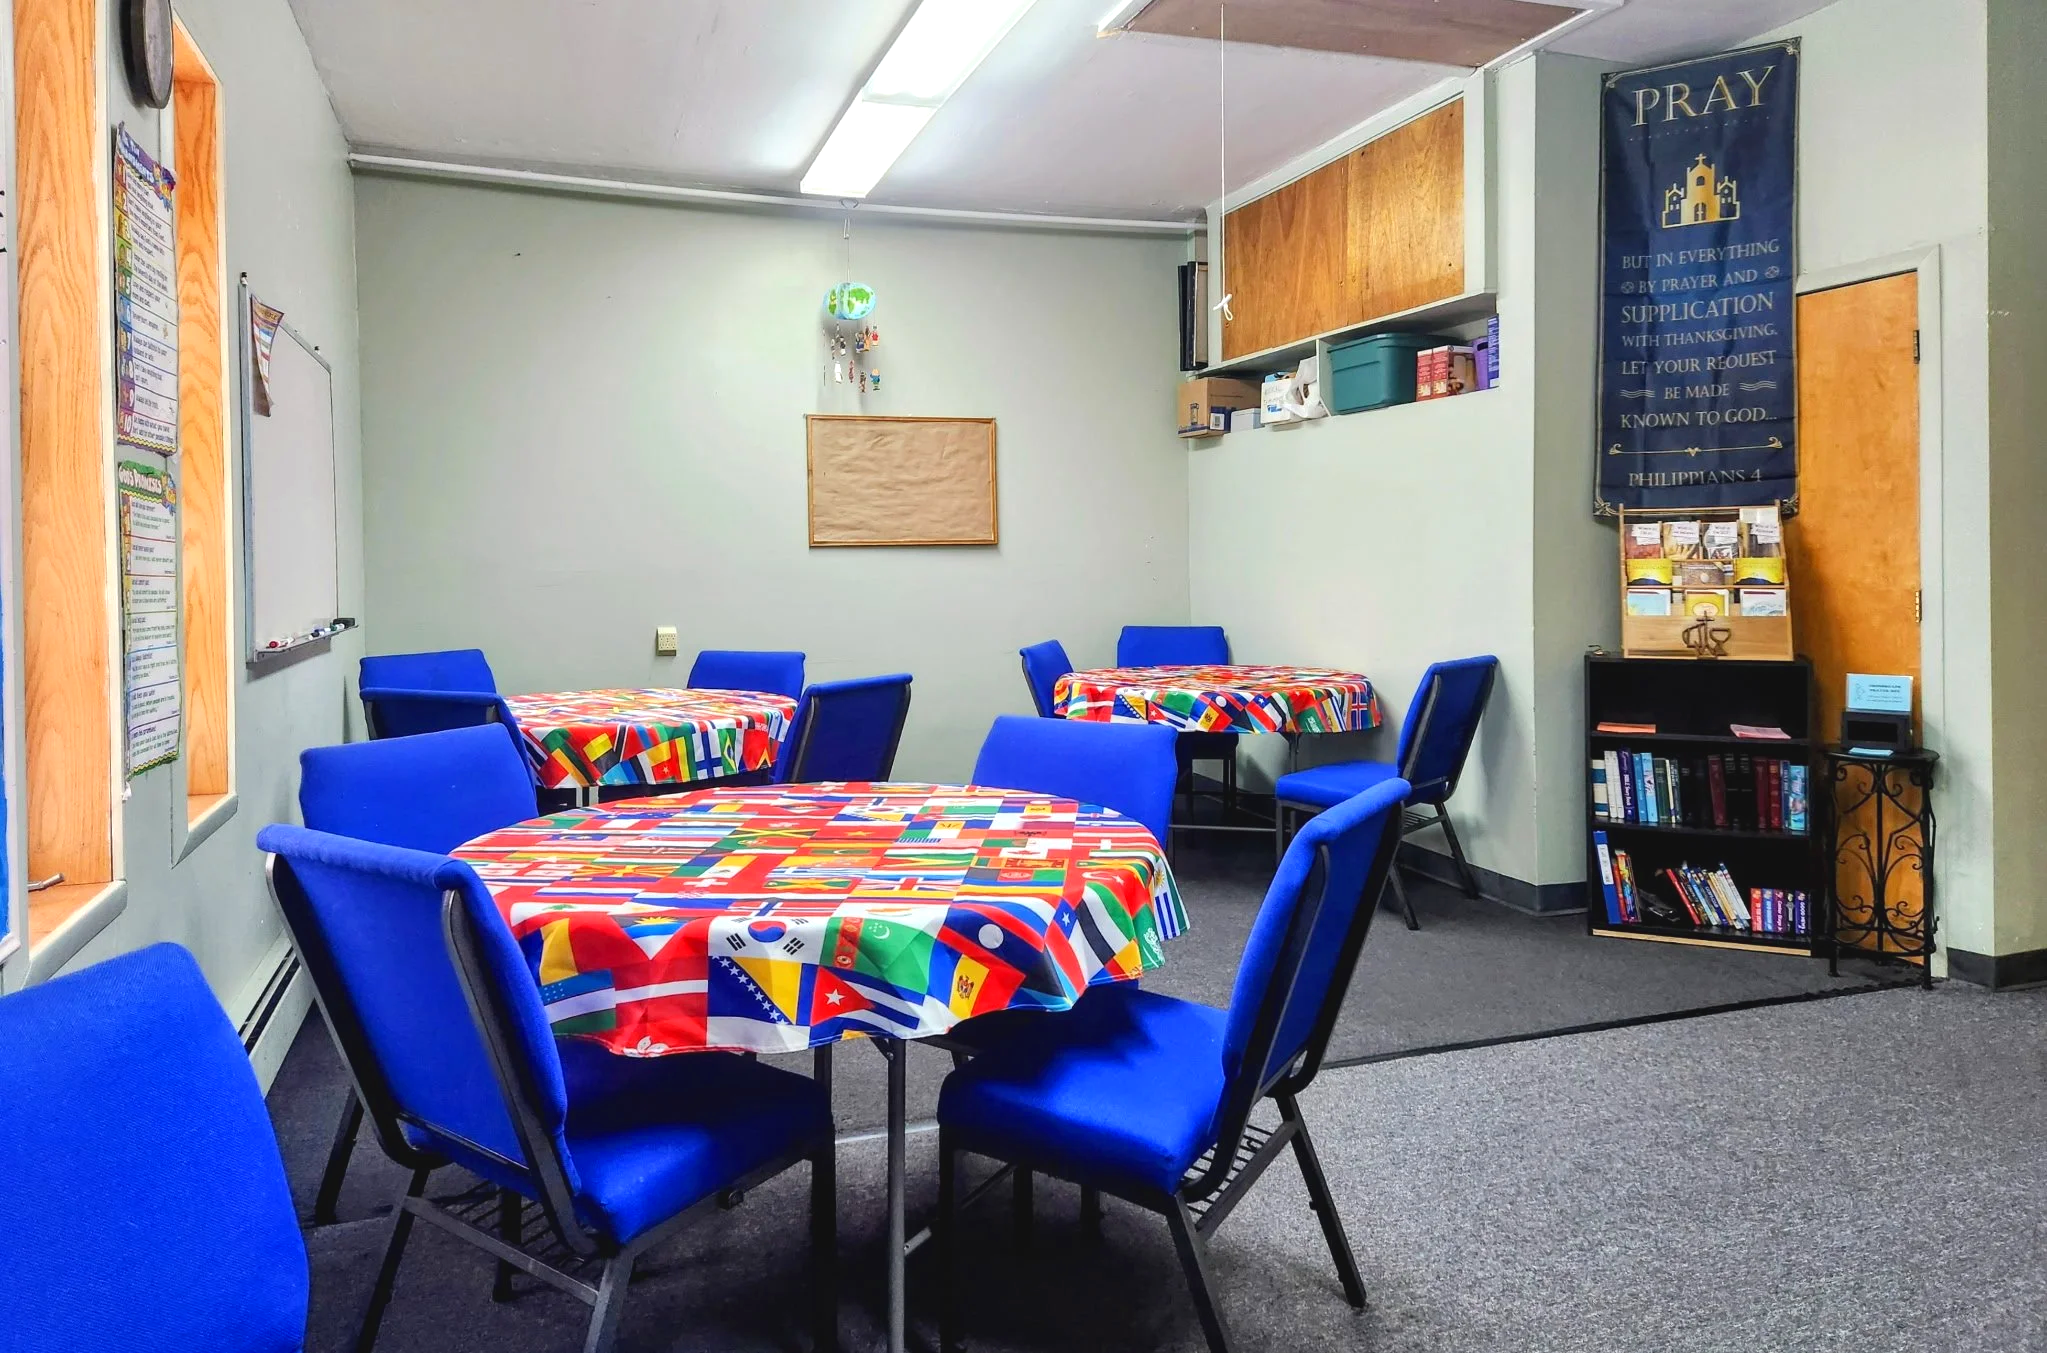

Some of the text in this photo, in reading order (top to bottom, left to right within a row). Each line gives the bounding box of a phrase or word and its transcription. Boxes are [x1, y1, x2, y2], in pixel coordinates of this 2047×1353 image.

[1631, 65, 1776, 127] PRAY
[1622, 238, 1779, 270] BUT IN EVERYTHING
[1638, 269, 1758, 294] BY PRAYER AND
[1621, 291, 1774, 325] SUPPLICATION
[1622, 323, 1778, 348] WITH THANKSGIVING.
[1621, 360, 1647, 375] LET
[1654, 358, 1700, 374] YOUR
[1664, 383, 1730, 400] BE MADE
[1621, 406, 1778, 429] KNOWN TO GOD...
[1628, 468, 1762, 487] PHILIPPIANS 4
